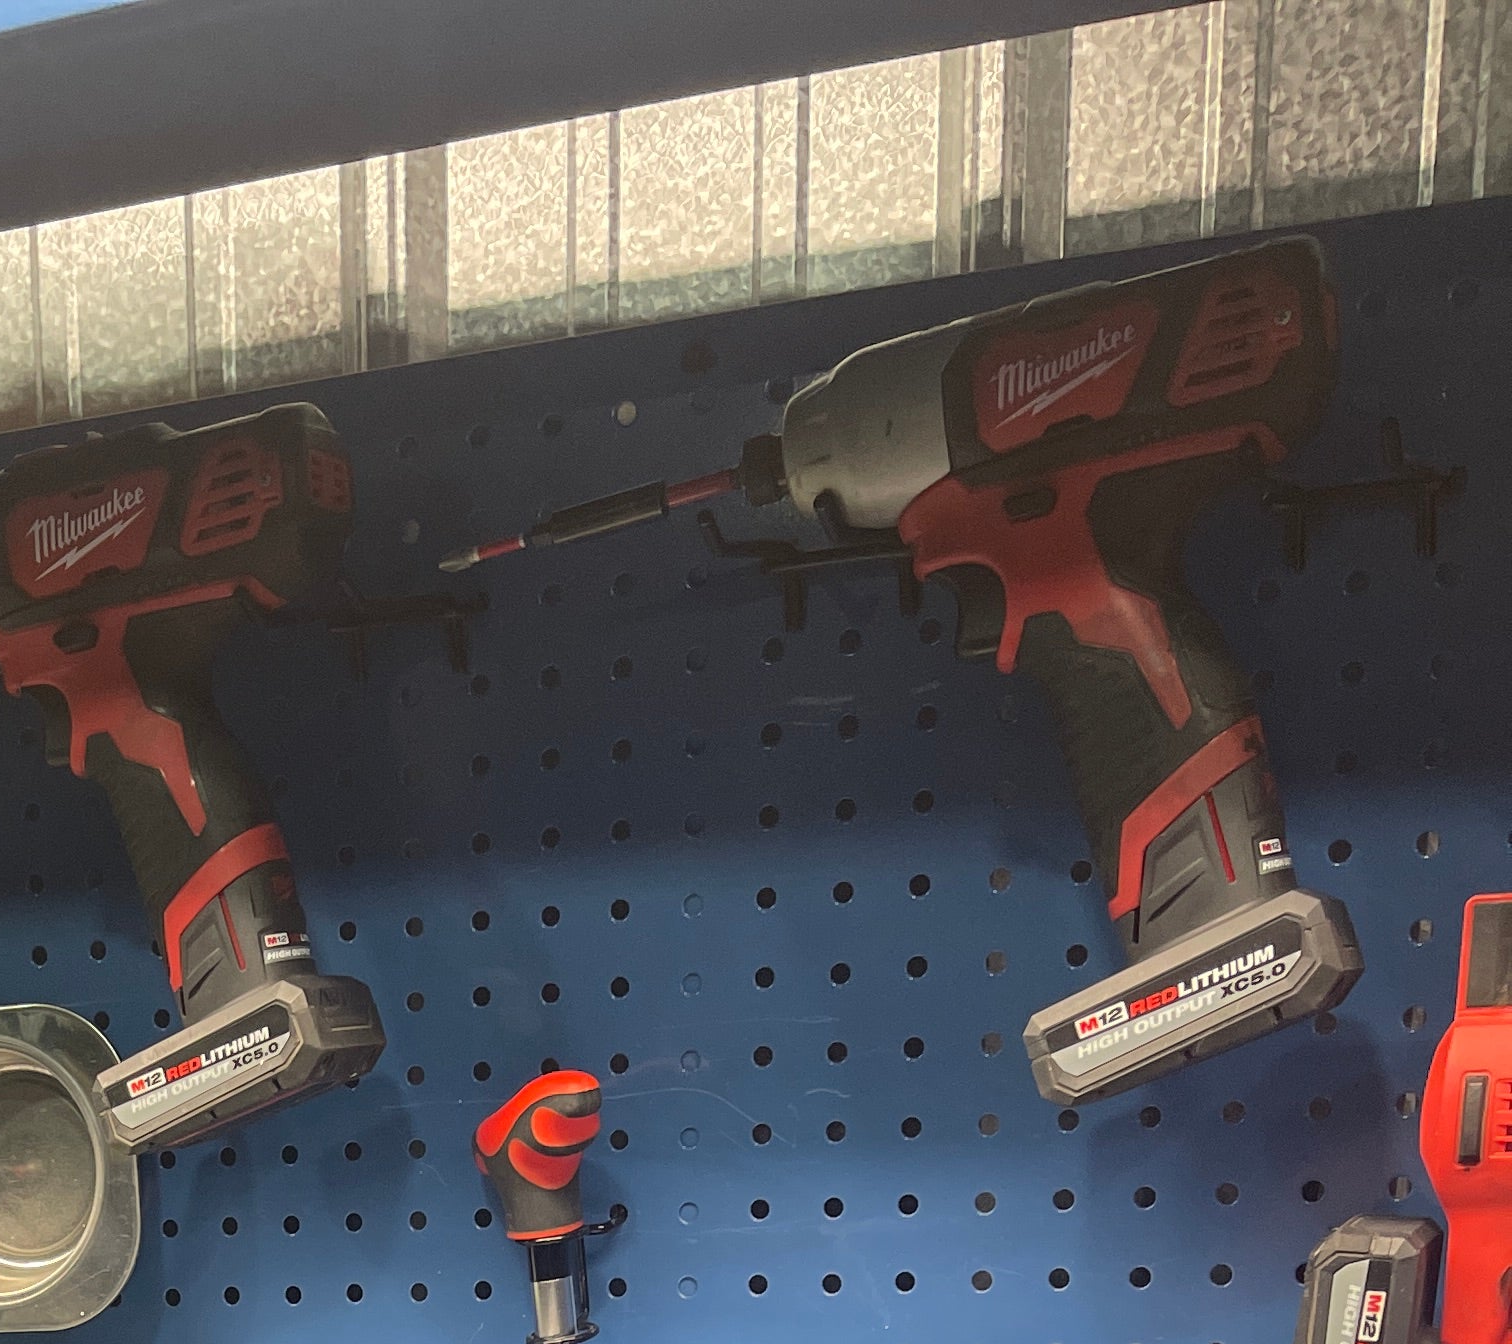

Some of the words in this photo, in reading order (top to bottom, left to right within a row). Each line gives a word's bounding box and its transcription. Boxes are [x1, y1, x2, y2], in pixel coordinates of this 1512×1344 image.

[988, 324, 1138, 410] Milwaukee
[26, 486, 146, 564] Milwaukee
[1078, 1027, 1129, 1059] HIGH
[1133, 991, 1217, 1034] OUTPUT
[1221, 962, 1286, 998] XC5.0
[1079, 1006, 1124, 1034] M12
[130, 1072, 163, 1094] M12
[131, 1091, 169, 1112] HIGH
[171, 1063, 231, 1095] OUTPUT
[232, 1042, 279, 1070] XC5.0
[1341, 1284, 1362, 1336] HIGH
[1362, 1294, 1384, 1338] M12
